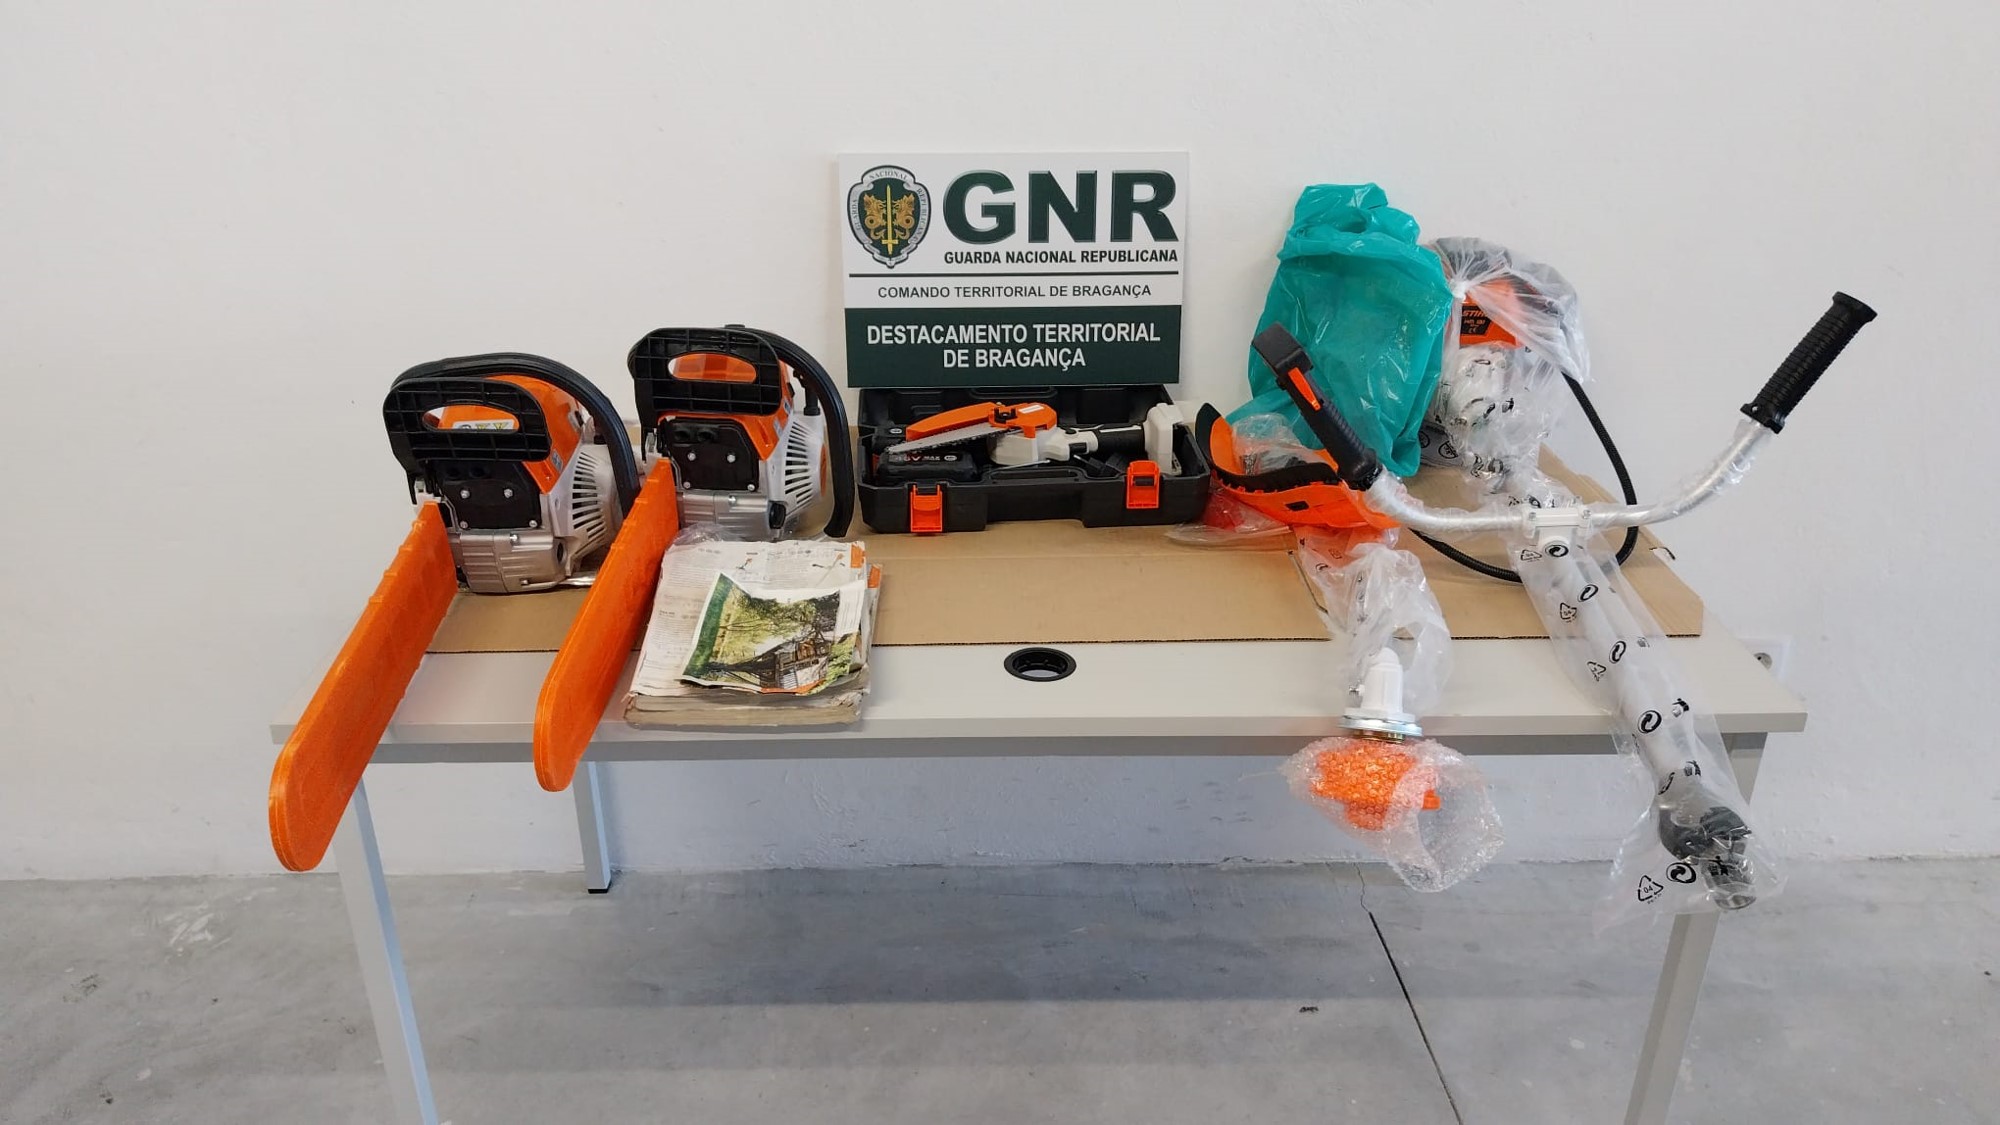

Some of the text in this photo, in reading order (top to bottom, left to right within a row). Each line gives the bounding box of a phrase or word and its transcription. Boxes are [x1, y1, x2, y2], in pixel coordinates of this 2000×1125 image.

[869, 170, 908, 180] NACIONAL
[943, 170, 1179, 245] GNR
[943, 249, 1178, 265] GUARDA NACIONAL REPUBLICANA
[878, 284, 1152, 299] COMANDO TERRITORIAL DE BRAGANÇA
[867, 322, 1161, 345] DESTACAMENTO TERRITORIAL
[943, 347, 1086, 372] DE BRAGANÇA
